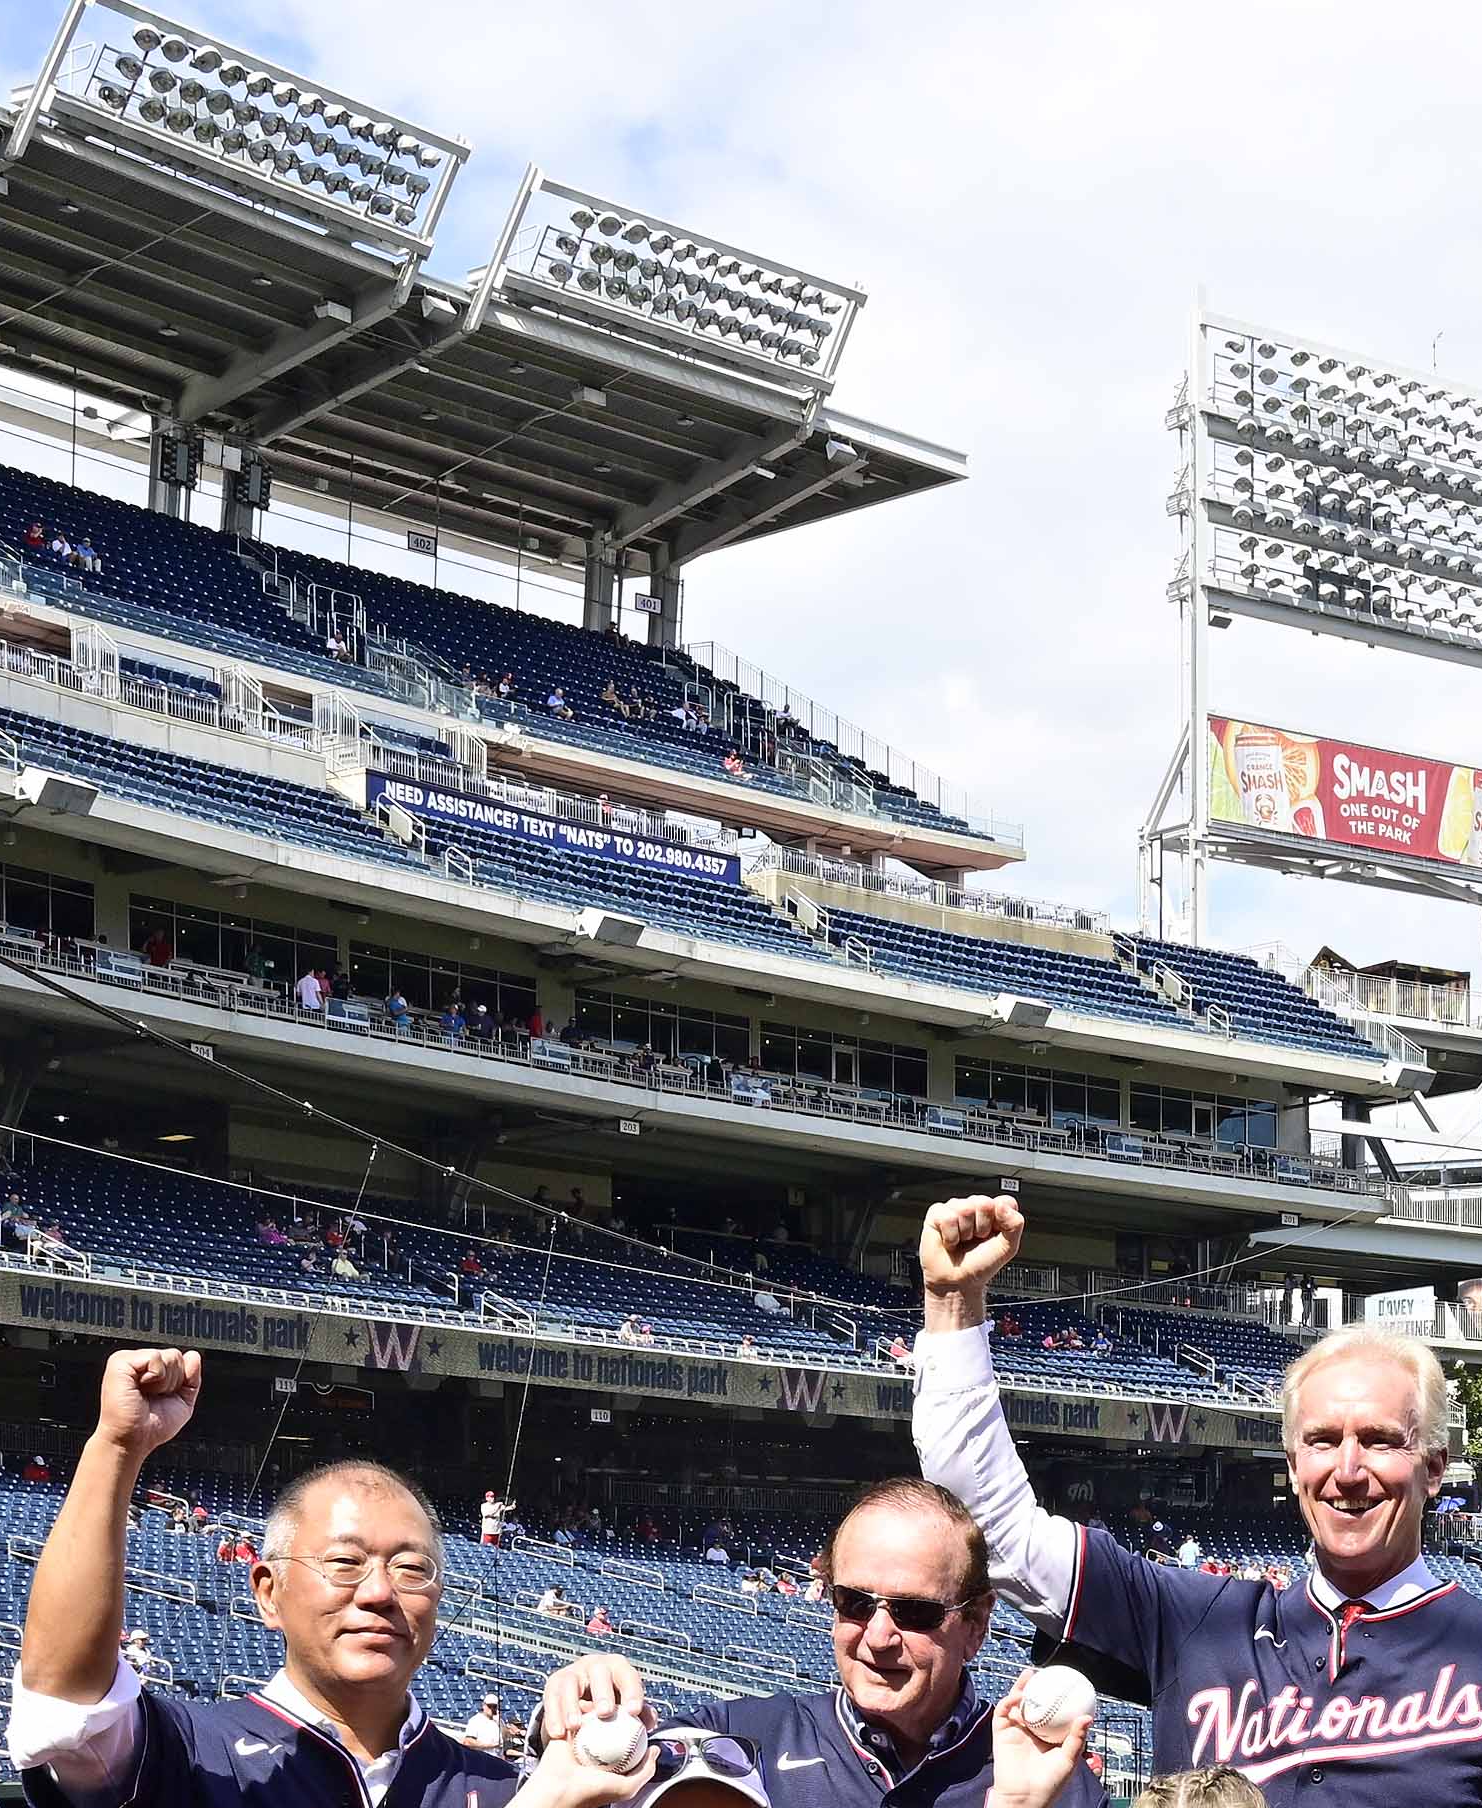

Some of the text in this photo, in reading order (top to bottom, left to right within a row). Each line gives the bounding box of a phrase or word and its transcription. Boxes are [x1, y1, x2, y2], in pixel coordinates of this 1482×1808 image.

[414, 537, 431, 550] 402
[640, 599, 657, 610] 401
[1240, 771, 1284, 793] SMASH
[1332, 753, 1427, 815] SMASH
[384, 780, 424, 806] NEED
[426, 792, 519, 832] ASSISTANCE?
[522, 816, 556, 839] TEXT
[614, 837, 634, 857] TO
[636, 841, 727, 876] 202.980.4357
[1340, 803, 1421, 831] ONE OUT OF
[1348, 820, 1412, 845] THE PARK
[622, 1122, 637, 1131] 203
[19, 1282, 312, 1350] welcome to nationals park
[478, 1340, 728, 1400] welcome to nationals park
[1063, 1400, 1100, 1430] park
